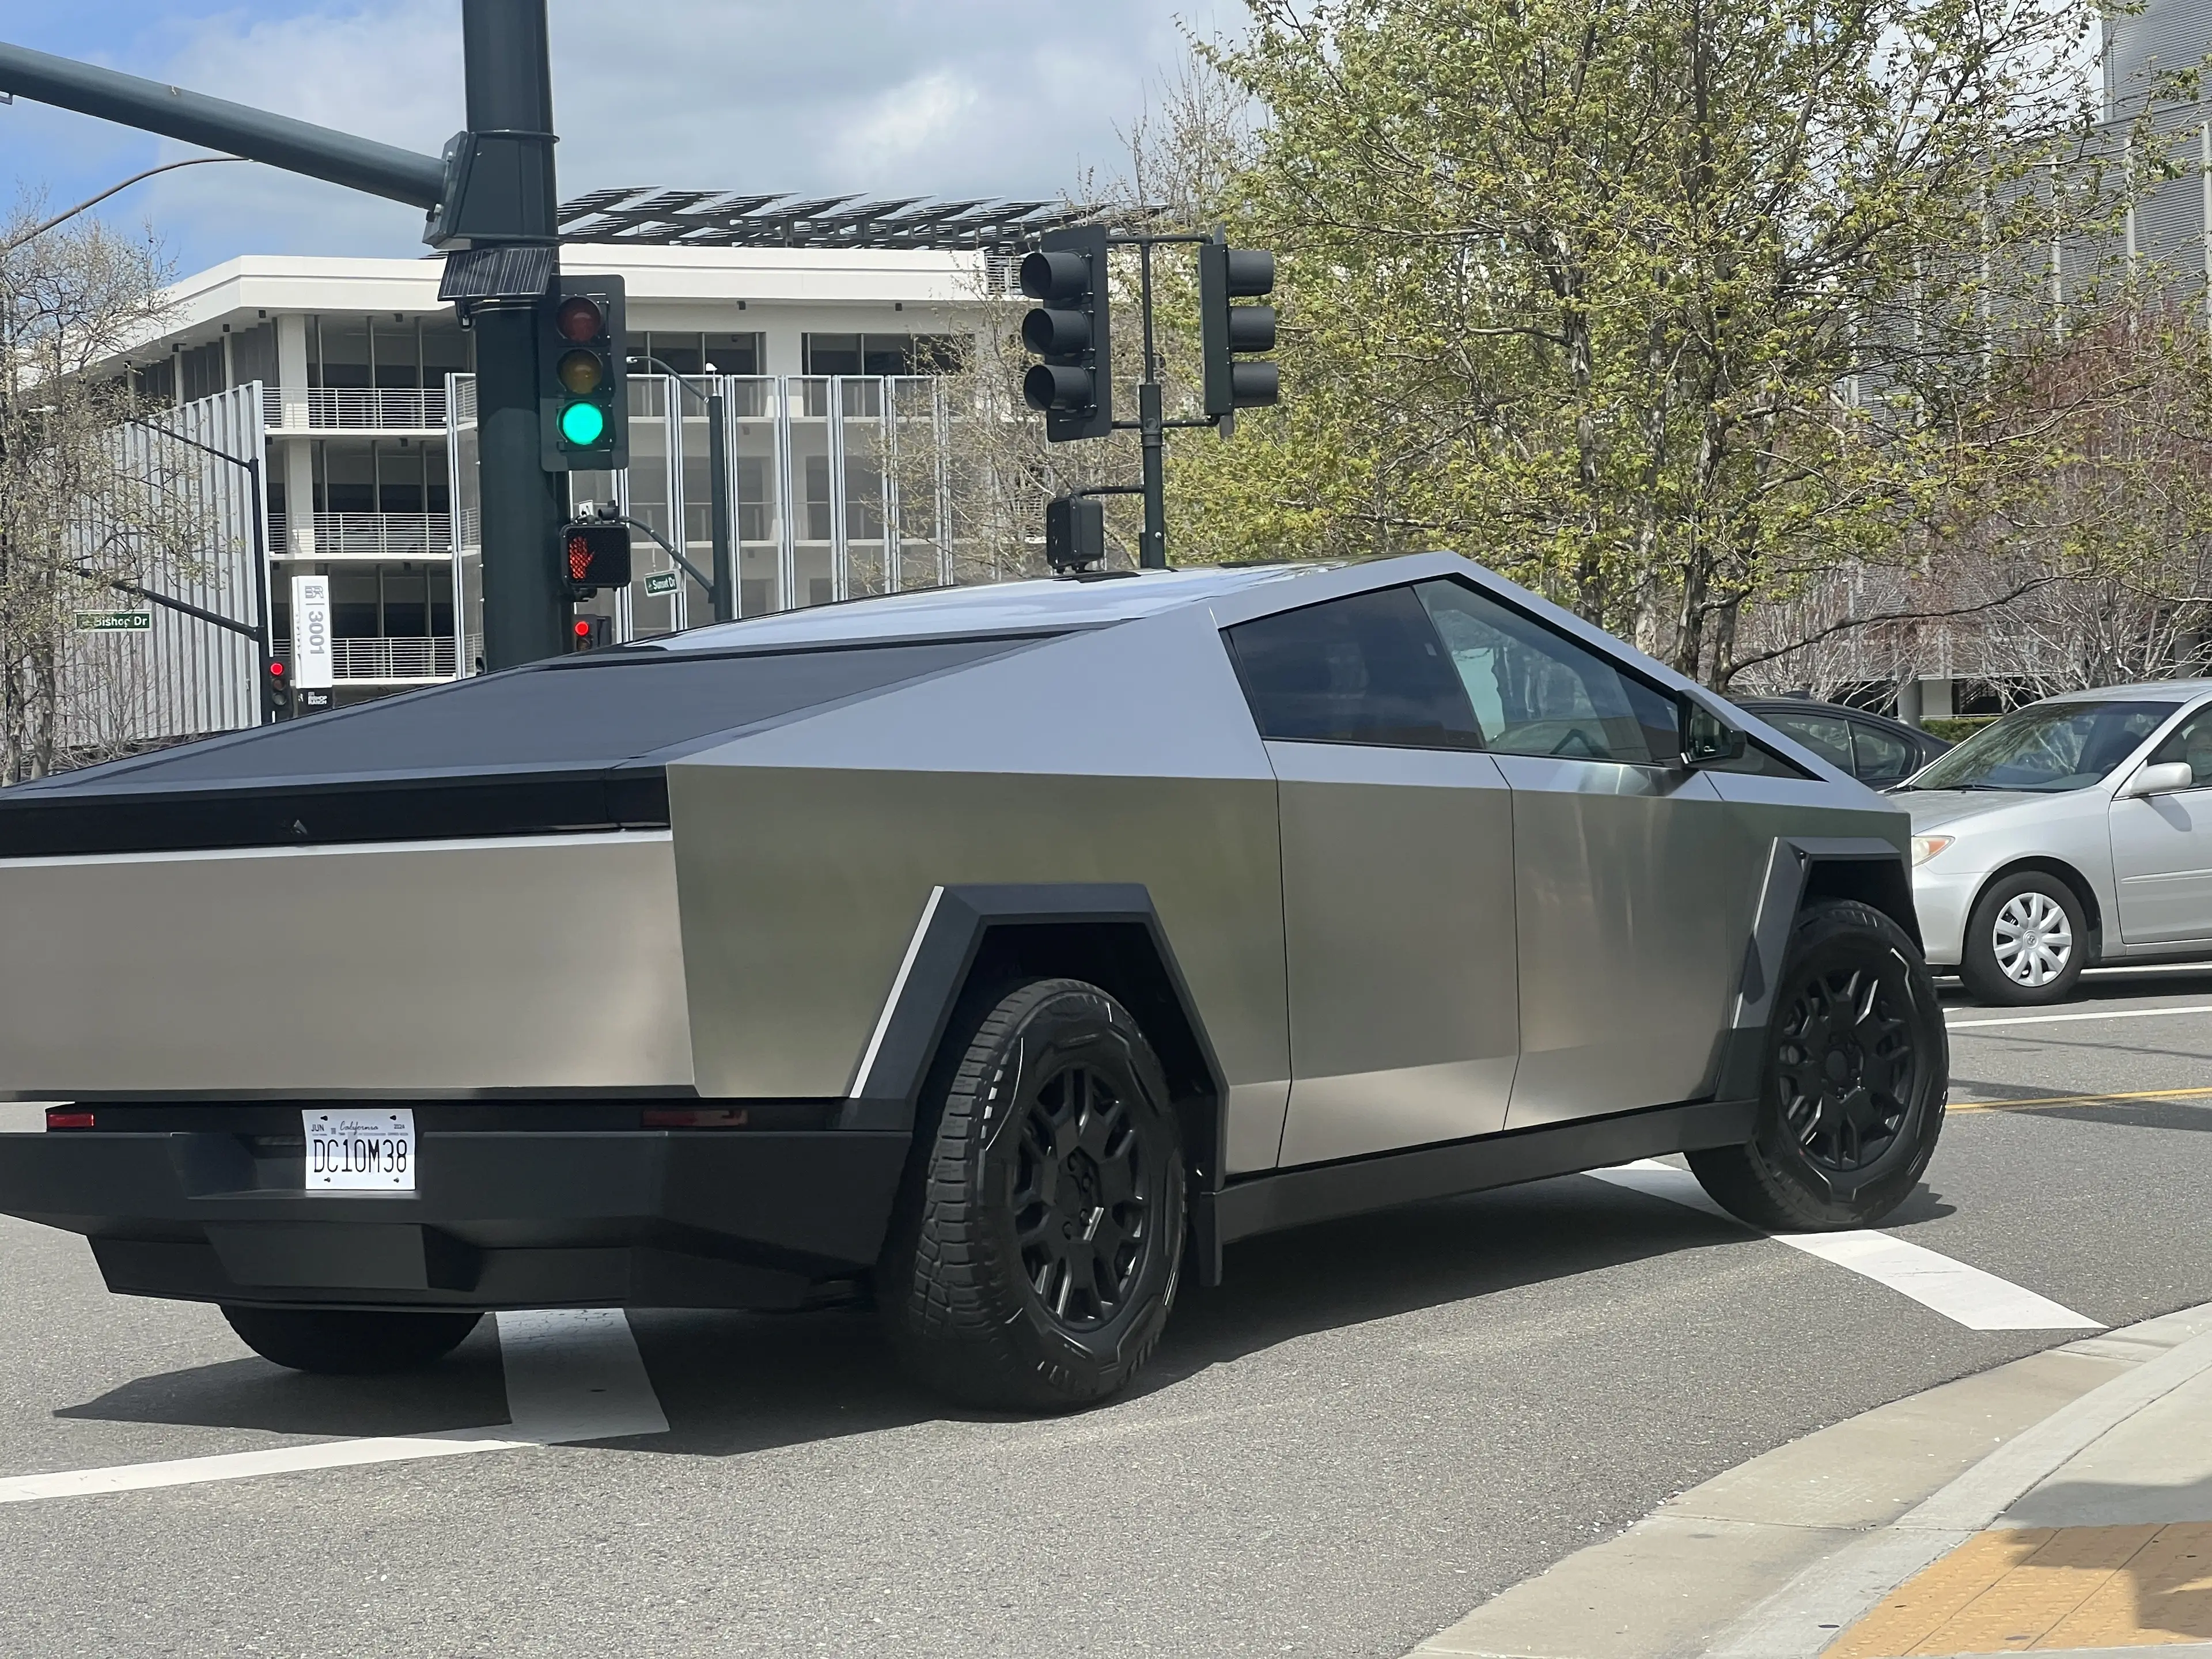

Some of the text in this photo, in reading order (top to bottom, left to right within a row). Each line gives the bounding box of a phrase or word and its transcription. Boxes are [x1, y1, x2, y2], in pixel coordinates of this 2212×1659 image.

[134, 616, 147, 626] Dr
[308, 611, 325, 654] 3001
[311, 1124, 324, 1132] JUN
[340, 1120, 378, 1135] California
[313, 1139, 407, 1173] DC10M38
